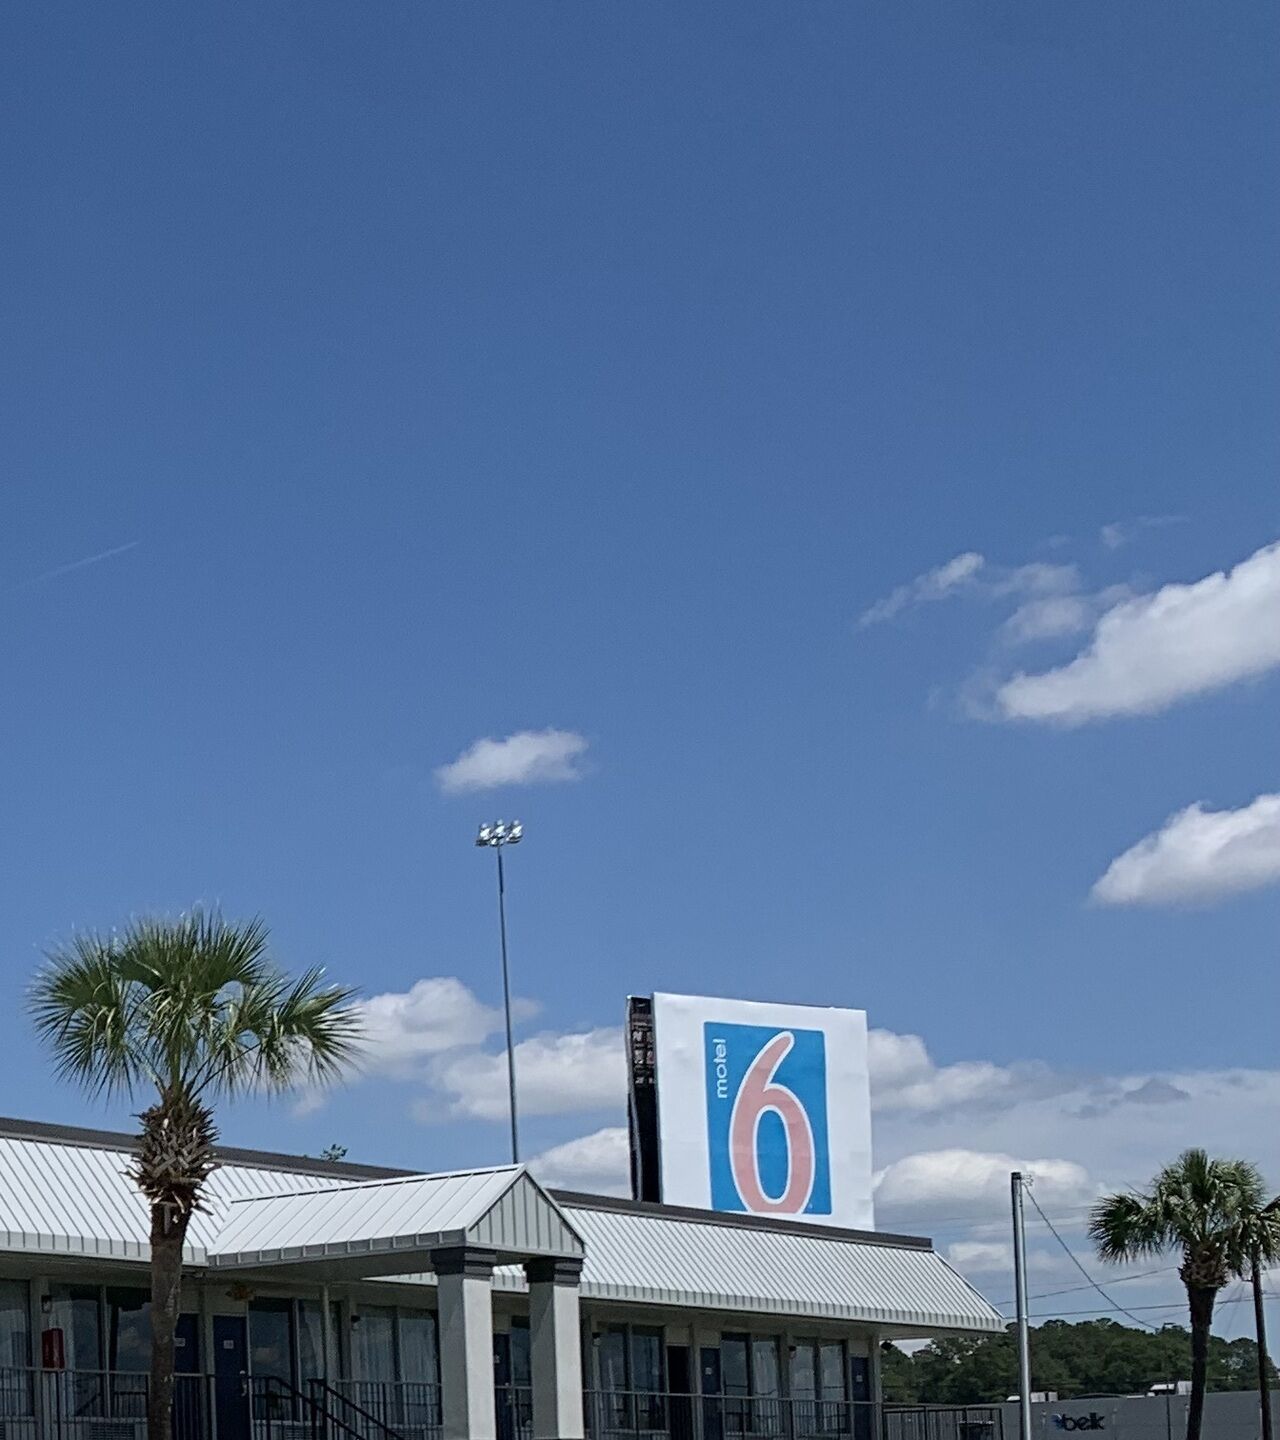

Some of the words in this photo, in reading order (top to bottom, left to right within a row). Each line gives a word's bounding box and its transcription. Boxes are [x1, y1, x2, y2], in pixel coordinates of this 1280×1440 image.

[713, 1038, 727, 1099] motel
[728, 1031, 816, 1214] 6
[1062, 1412, 1105, 1431] belk
